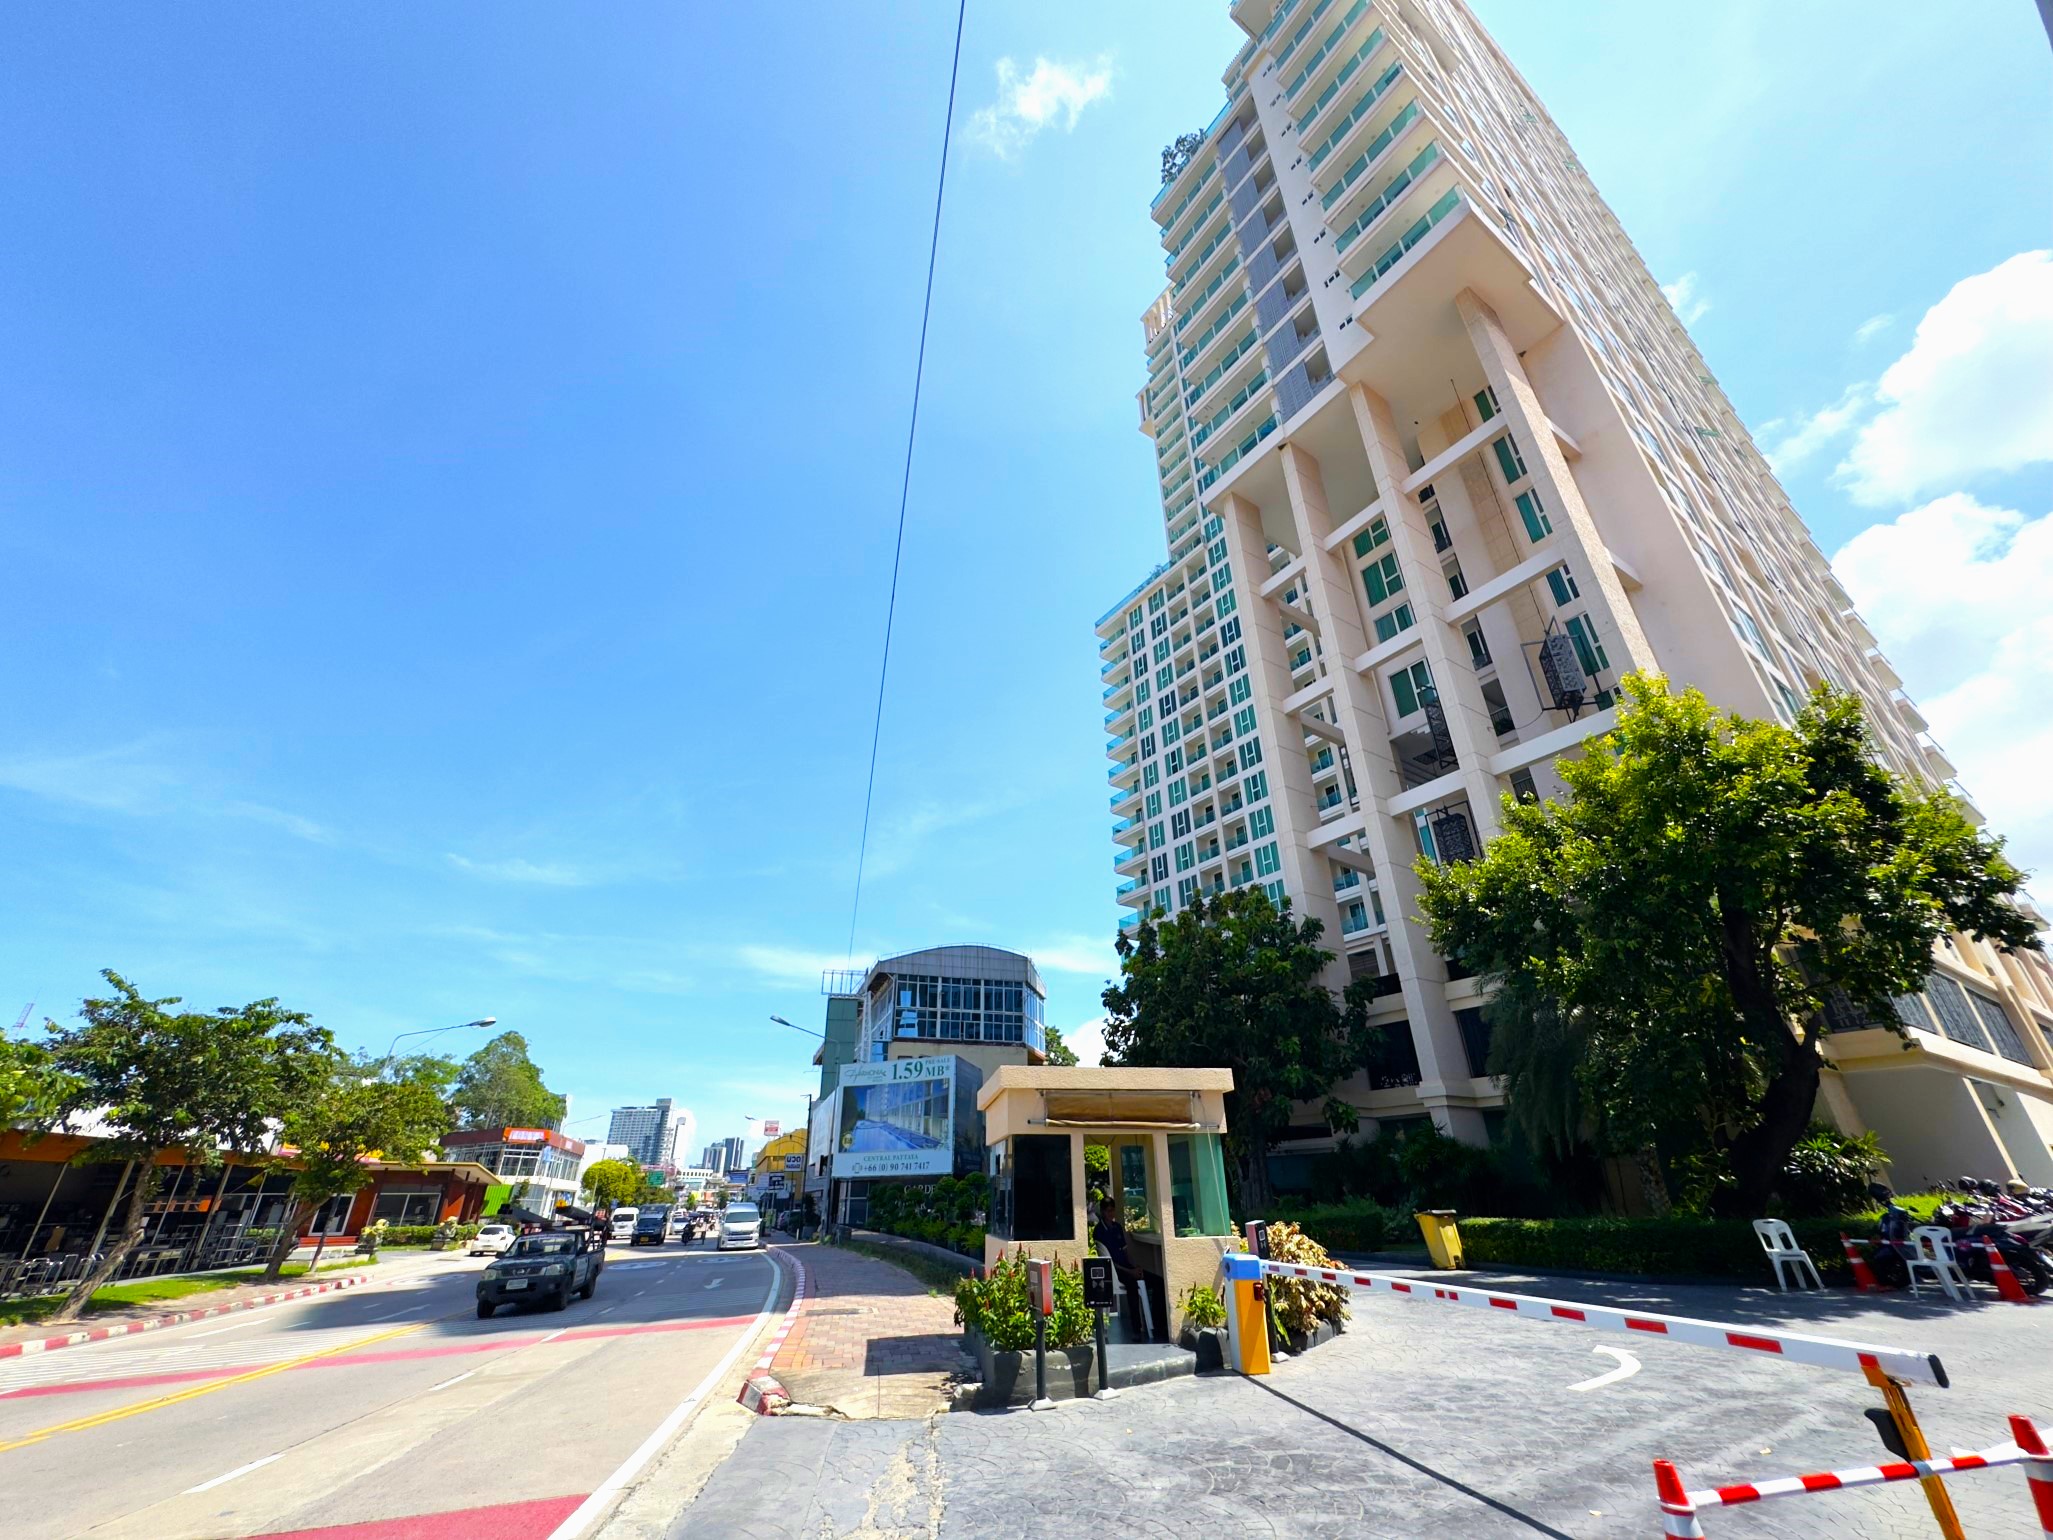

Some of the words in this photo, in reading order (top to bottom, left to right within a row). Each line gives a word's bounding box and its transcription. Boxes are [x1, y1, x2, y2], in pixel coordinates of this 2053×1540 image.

[892, 1060, 923, 1080] 1.59
[893, 1153, 919, 1161] PATTAYA
[864, 1164, 877, 1172] +66
[878, 1162, 889, 1172] (0)
[890, 1162, 899, 1171] 90
[900, 1162, 912, 1171] 741
[914, 1161, 930, 1170] 7417
